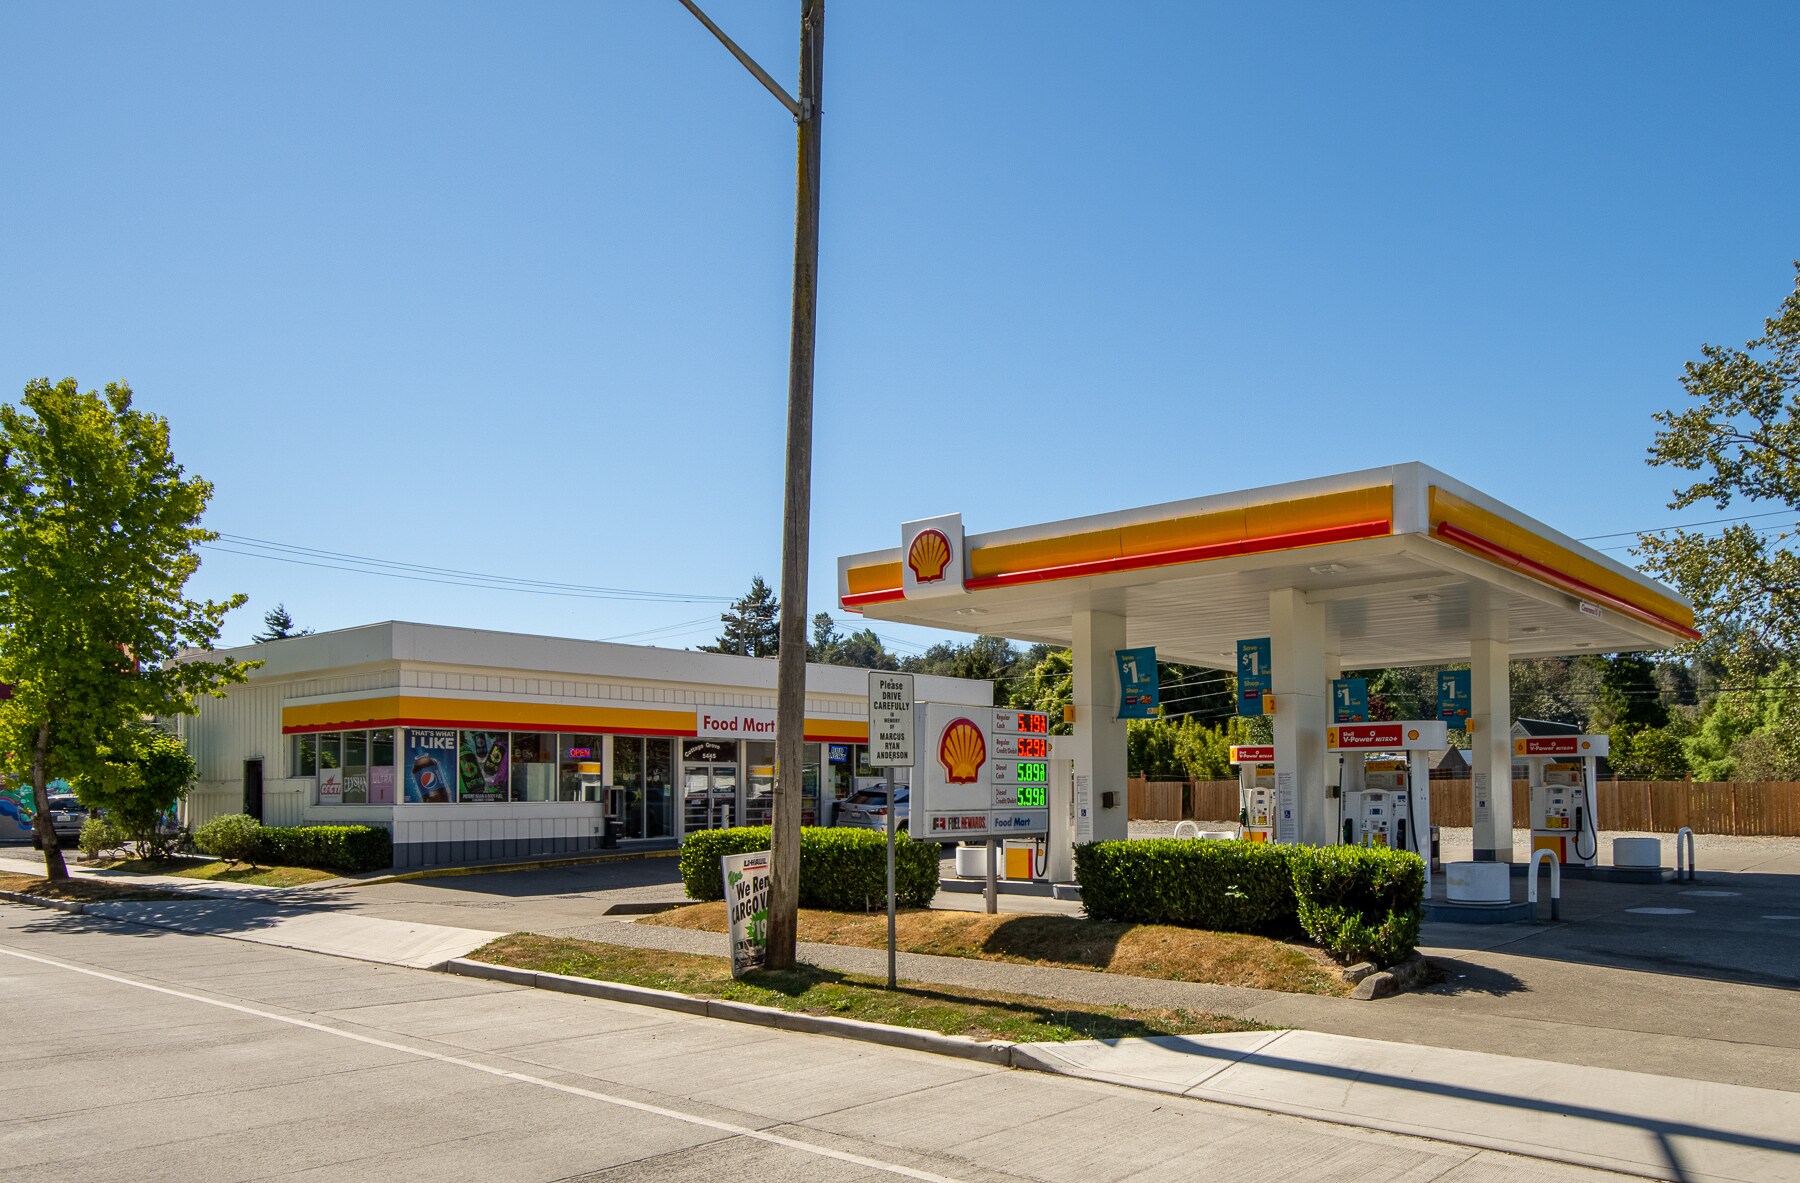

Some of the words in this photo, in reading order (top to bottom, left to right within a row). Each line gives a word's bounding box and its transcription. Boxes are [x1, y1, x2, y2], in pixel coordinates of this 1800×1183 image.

[1242, 652, 1258, 676] $1
[1122, 661, 1138, 683] $1
[880, 680, 903, 690] Please
[1442, 680, 1456, 699] $1
[883, 692, 902, 700] DRIVE
[1337, 688, 1350, 706] $1
[874, 702, 910, 710] CAREFULLY
[1270, 700, 1274, 710] 2
[703, 715, 738, 731] Food
[743, 718, 775, 732] Mart
[411, 736, 416, 748] I
[420, 736, 454, 749] LIKE
[996, 738, 1010, 746] Regular
[1330, 733, 1335, 743] 2
[684, 744, 704, 757] Cottage
[372, 776, 392, 784] ULTRA
[948, 817, 960, 830] FUEL
[995, 817, 1012, 827] Food
[1014, 816, 1031, 826] Mart
[736, 881, 750, 900] We
[732, 896, 758, 925] CARGO
